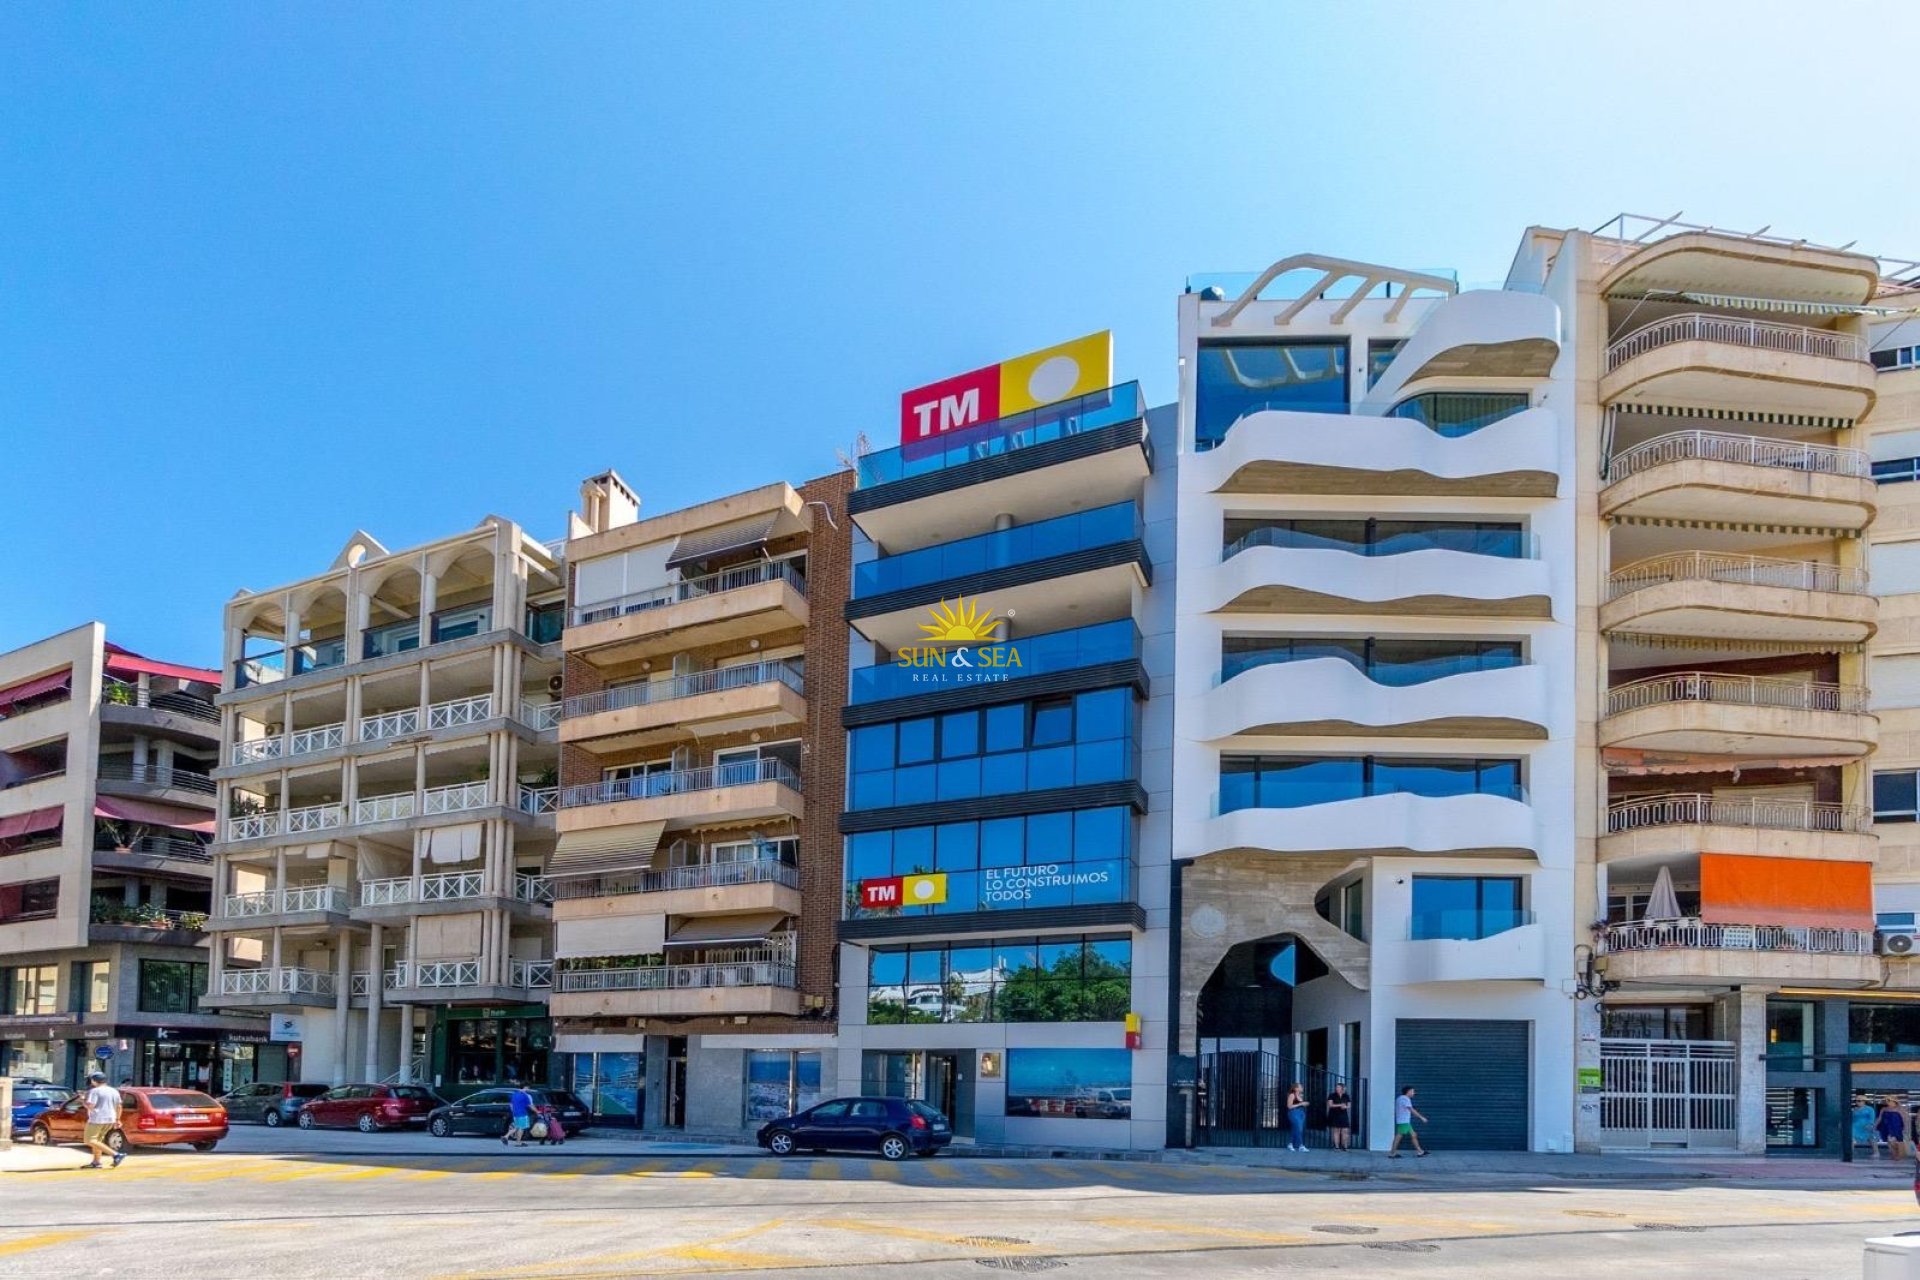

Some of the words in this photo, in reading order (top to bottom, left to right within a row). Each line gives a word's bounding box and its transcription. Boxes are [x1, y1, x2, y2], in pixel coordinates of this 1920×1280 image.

[914, 388, 979, 436] TM
[986, 867, 1001, 879] EL
[1003, 864, 1058, 878] FUTURO
[986, 879, 1003, 891] LO
[1005, 871, 1109, 890] CONSTRUIMOS
[867, 885, 896, 902] TM
[985, 888, 1032, 902] TODOS
